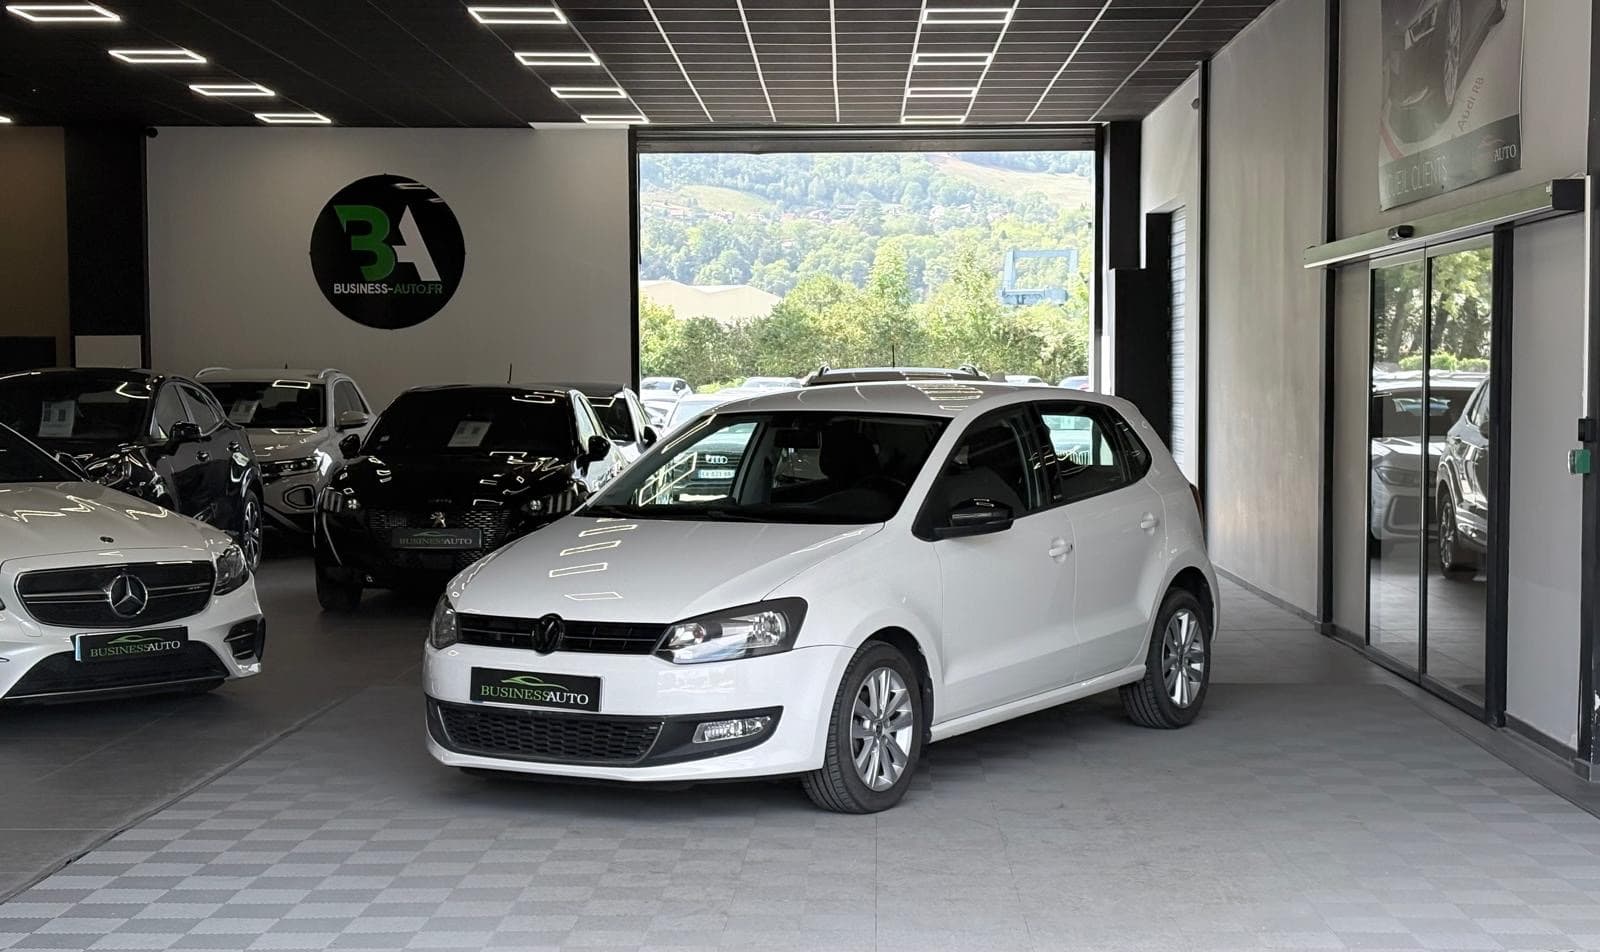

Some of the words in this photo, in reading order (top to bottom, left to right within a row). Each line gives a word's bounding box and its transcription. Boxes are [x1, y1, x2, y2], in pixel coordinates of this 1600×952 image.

[333, 205, 442, 281] BA
[333, 283, 443, 295] BUSINESS-AUTO.FR
[480, 685, 590, 706] BUSINESSAUTO
